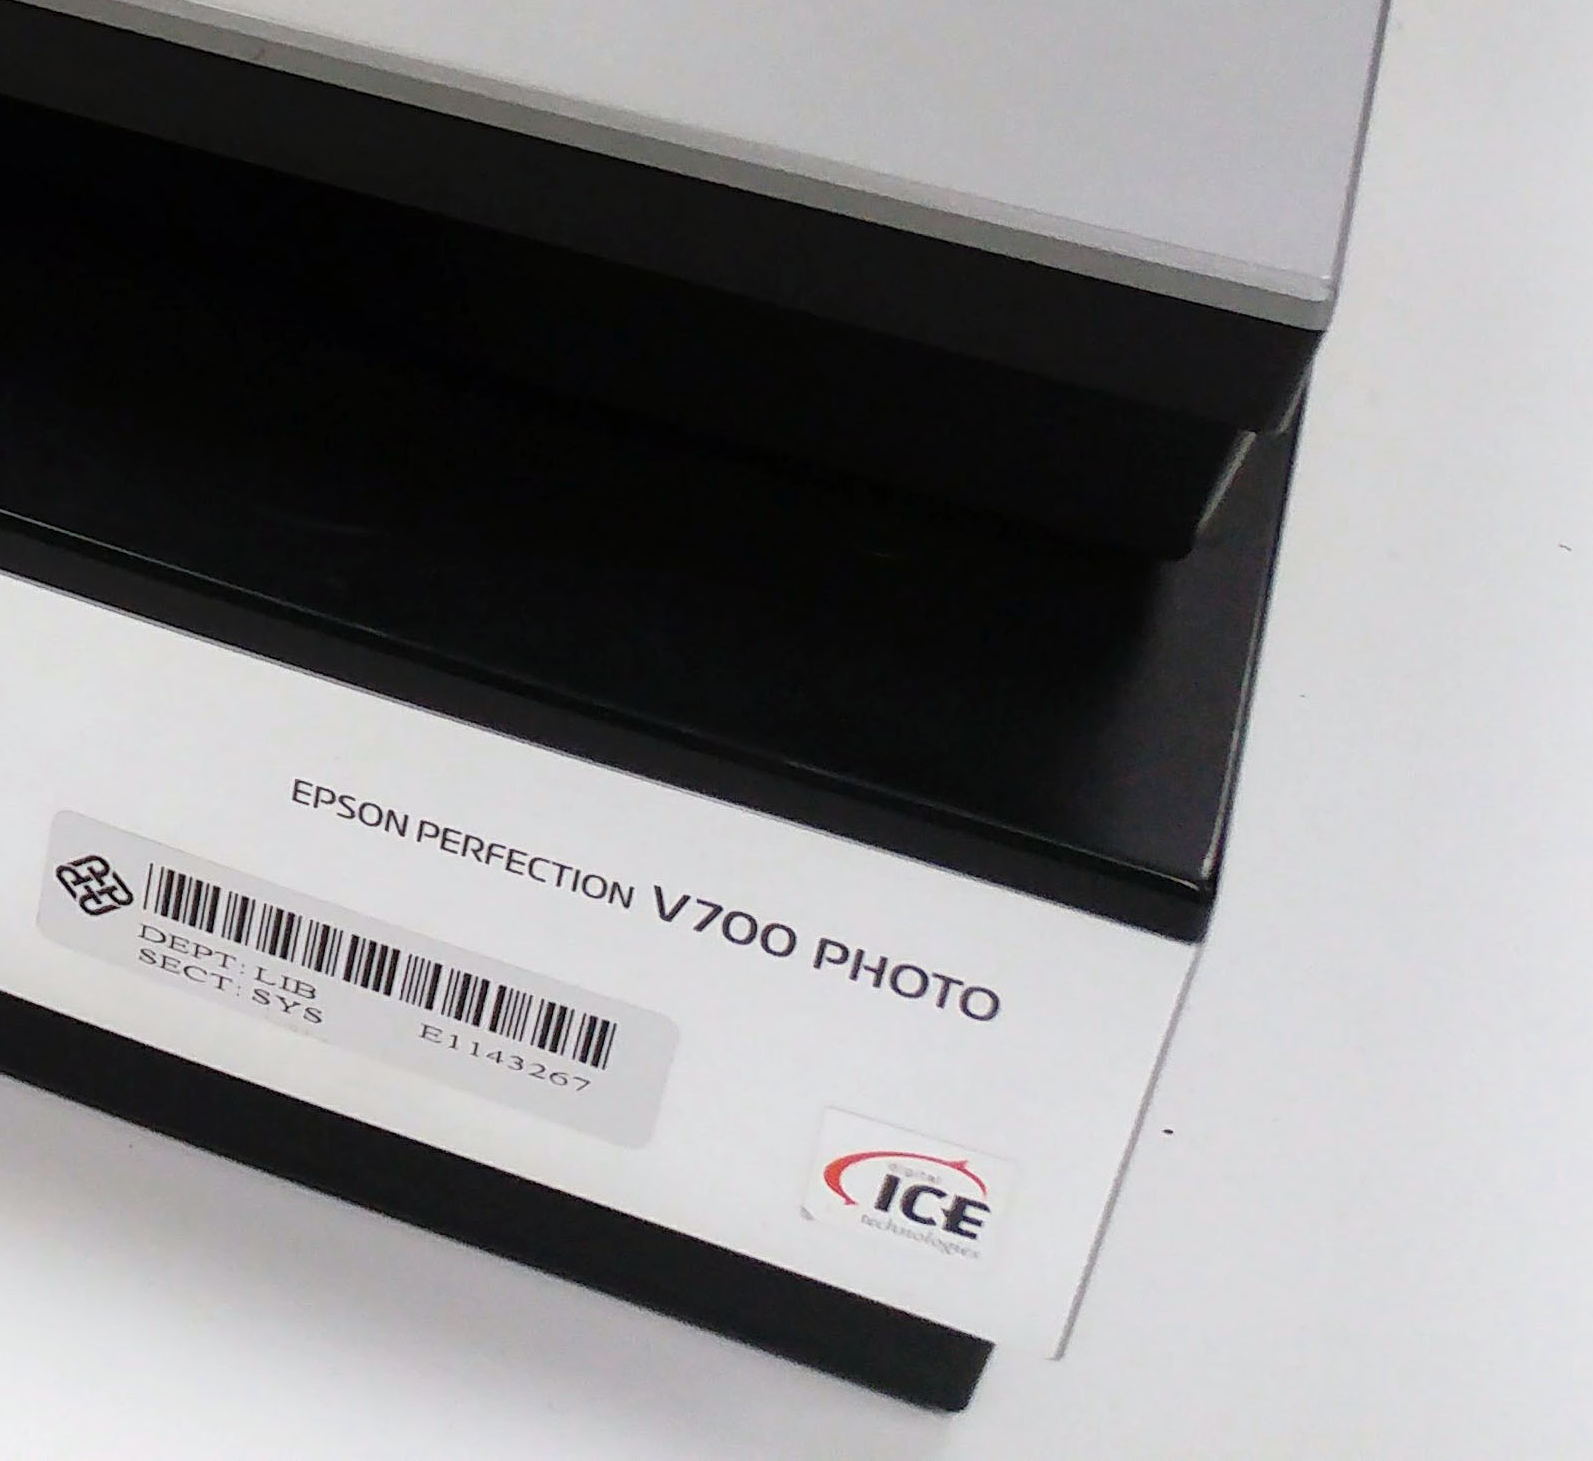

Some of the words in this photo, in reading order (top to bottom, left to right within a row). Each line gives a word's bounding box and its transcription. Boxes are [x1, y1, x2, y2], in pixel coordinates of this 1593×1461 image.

[290, 777, 409, 837] EPSON
[416, 820, 636, 910] PERFECTION
[653, 884, 797, 958] V700
[813, 936, 1002, 1022] PHOTO
[137, 922, 248, 977] DEPT:
[254, 964, 318, 1000] LIB
[138, 947, 242, 998] SECT:
[250, 988, 325, 1025] SYS
[418, 1022, 593, 1094] E1143267
[874, 1173, 992, 1240] ICE
